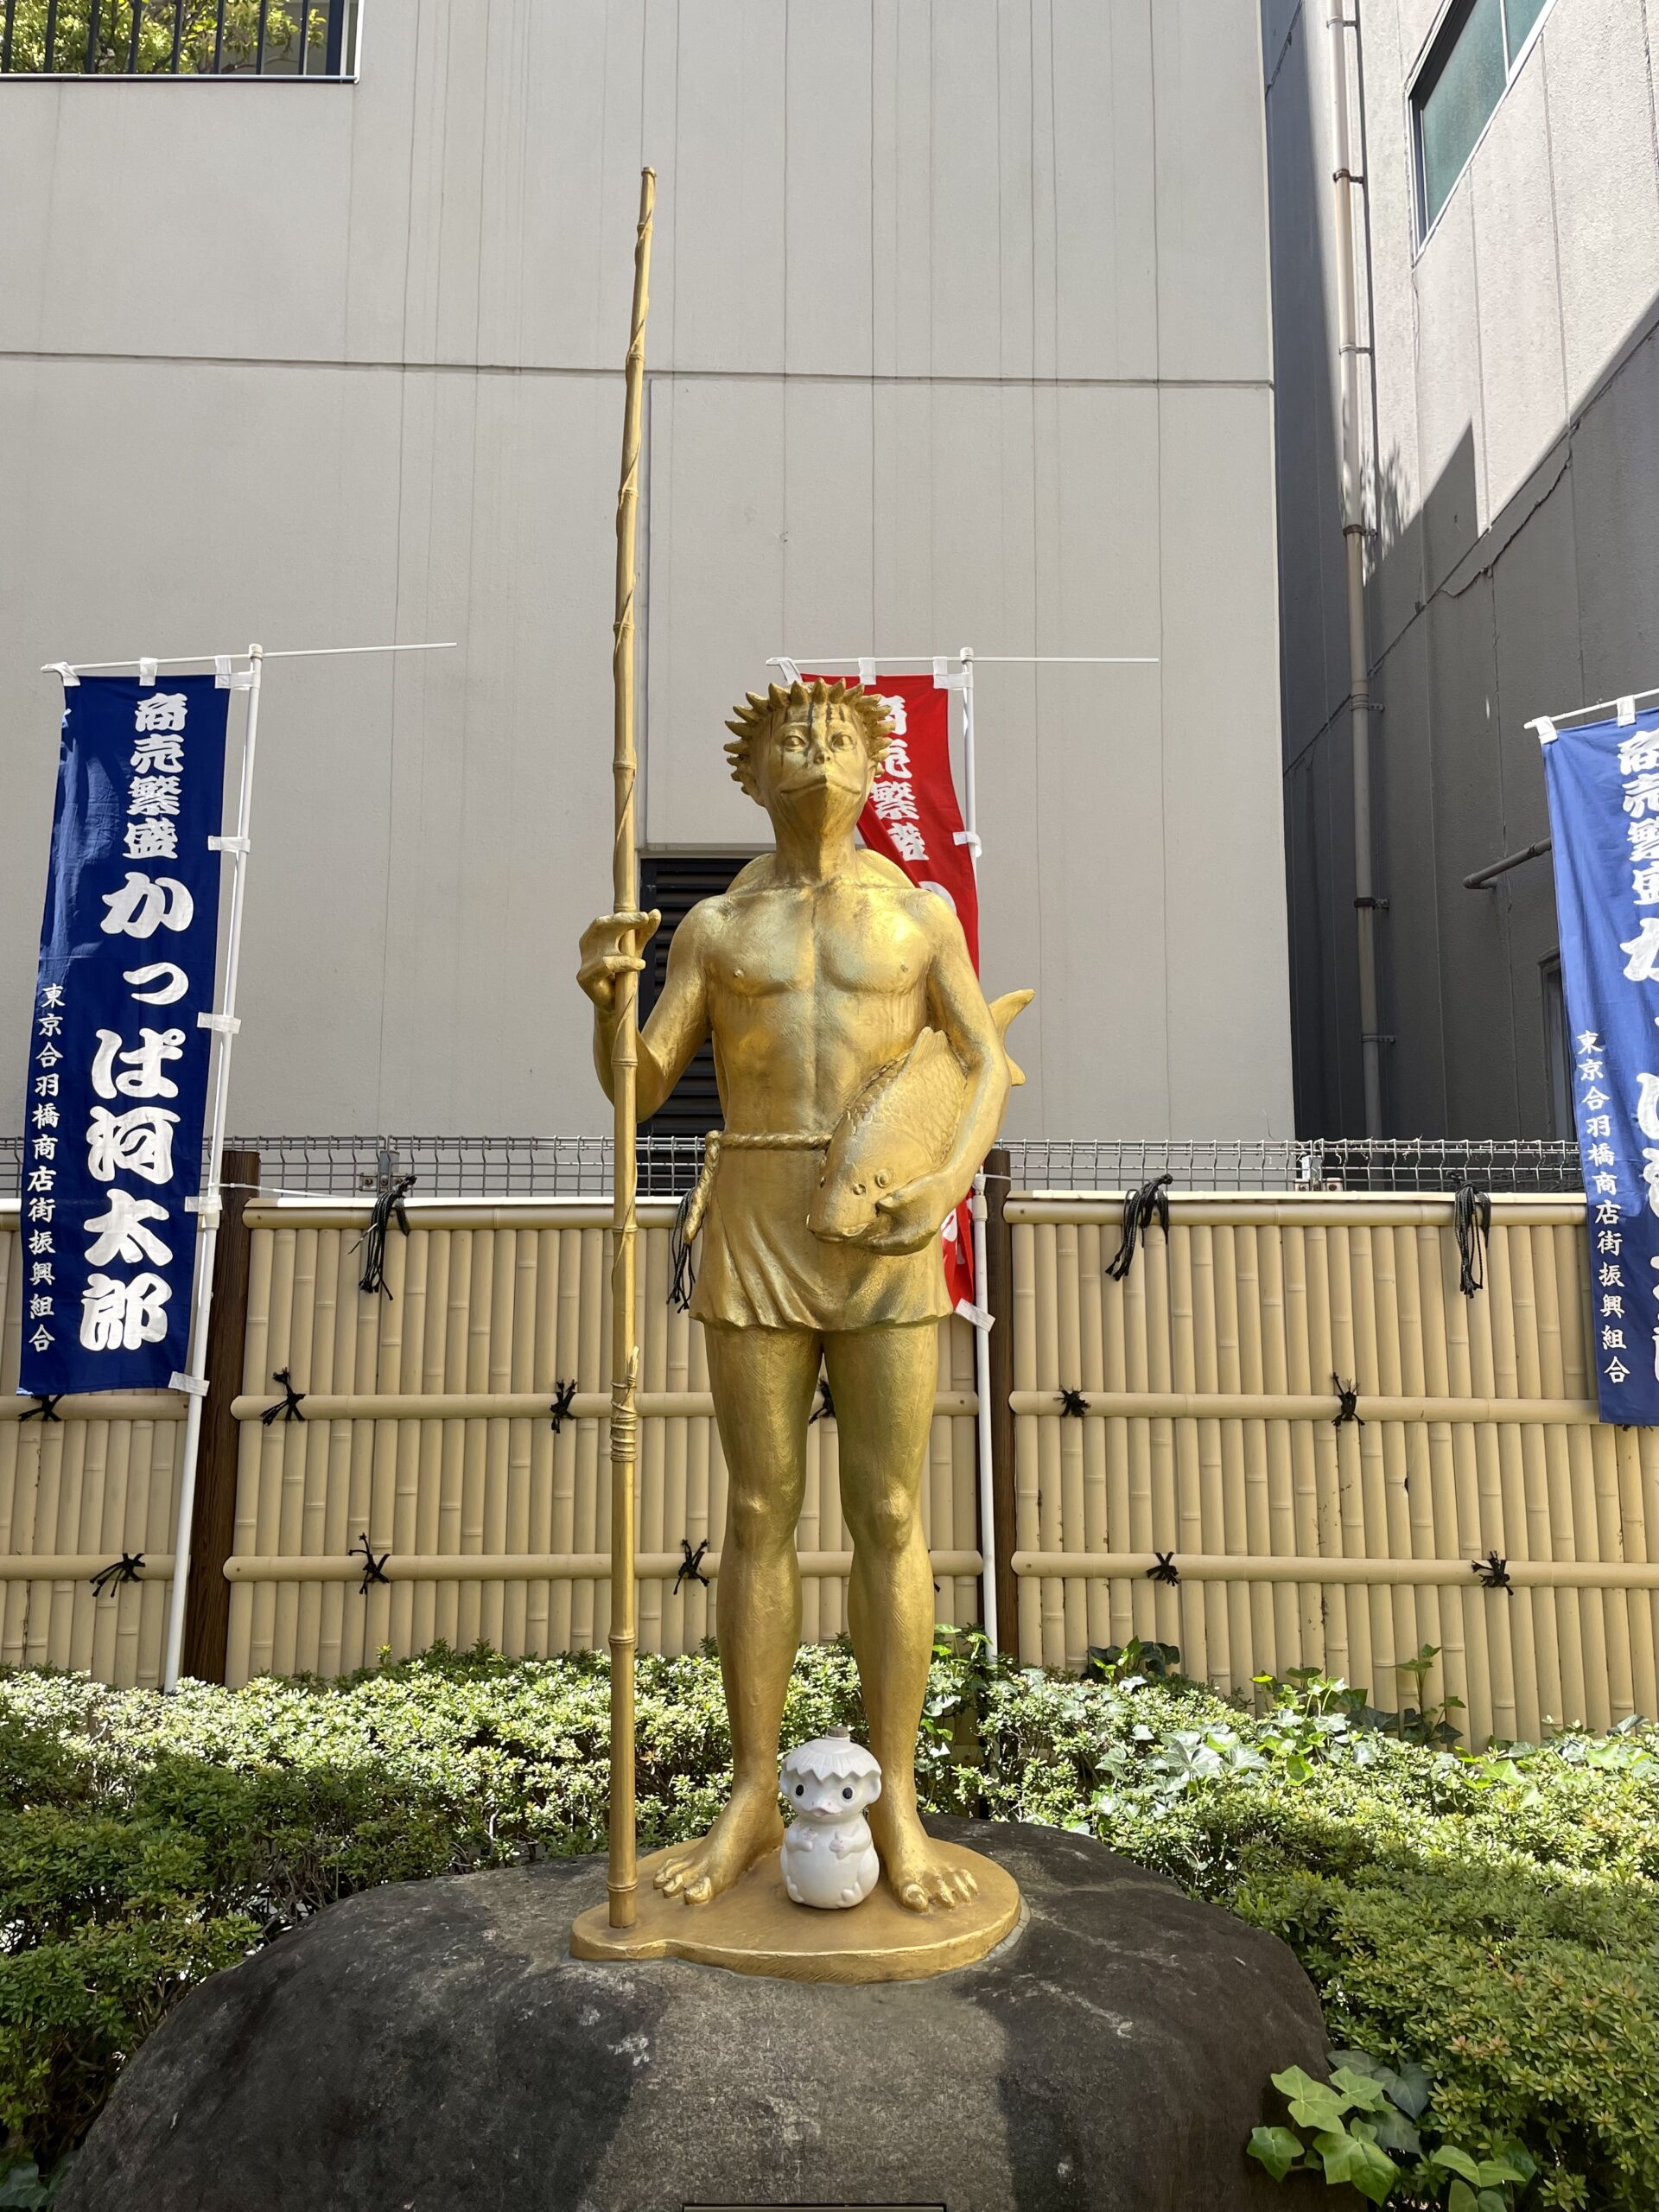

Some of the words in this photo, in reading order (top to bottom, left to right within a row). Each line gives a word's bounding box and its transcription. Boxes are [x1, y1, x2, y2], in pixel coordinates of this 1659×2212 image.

[123, 693, 188, 859] 商売繁盛
[27, 983, 66, 1352] 東京合羽橋商店街振興組合
[79, 872, 194, 1351] かっぱ河太郎
[1576, 1030, 1630, 1383] 東京合羽橋商店街振興組合
